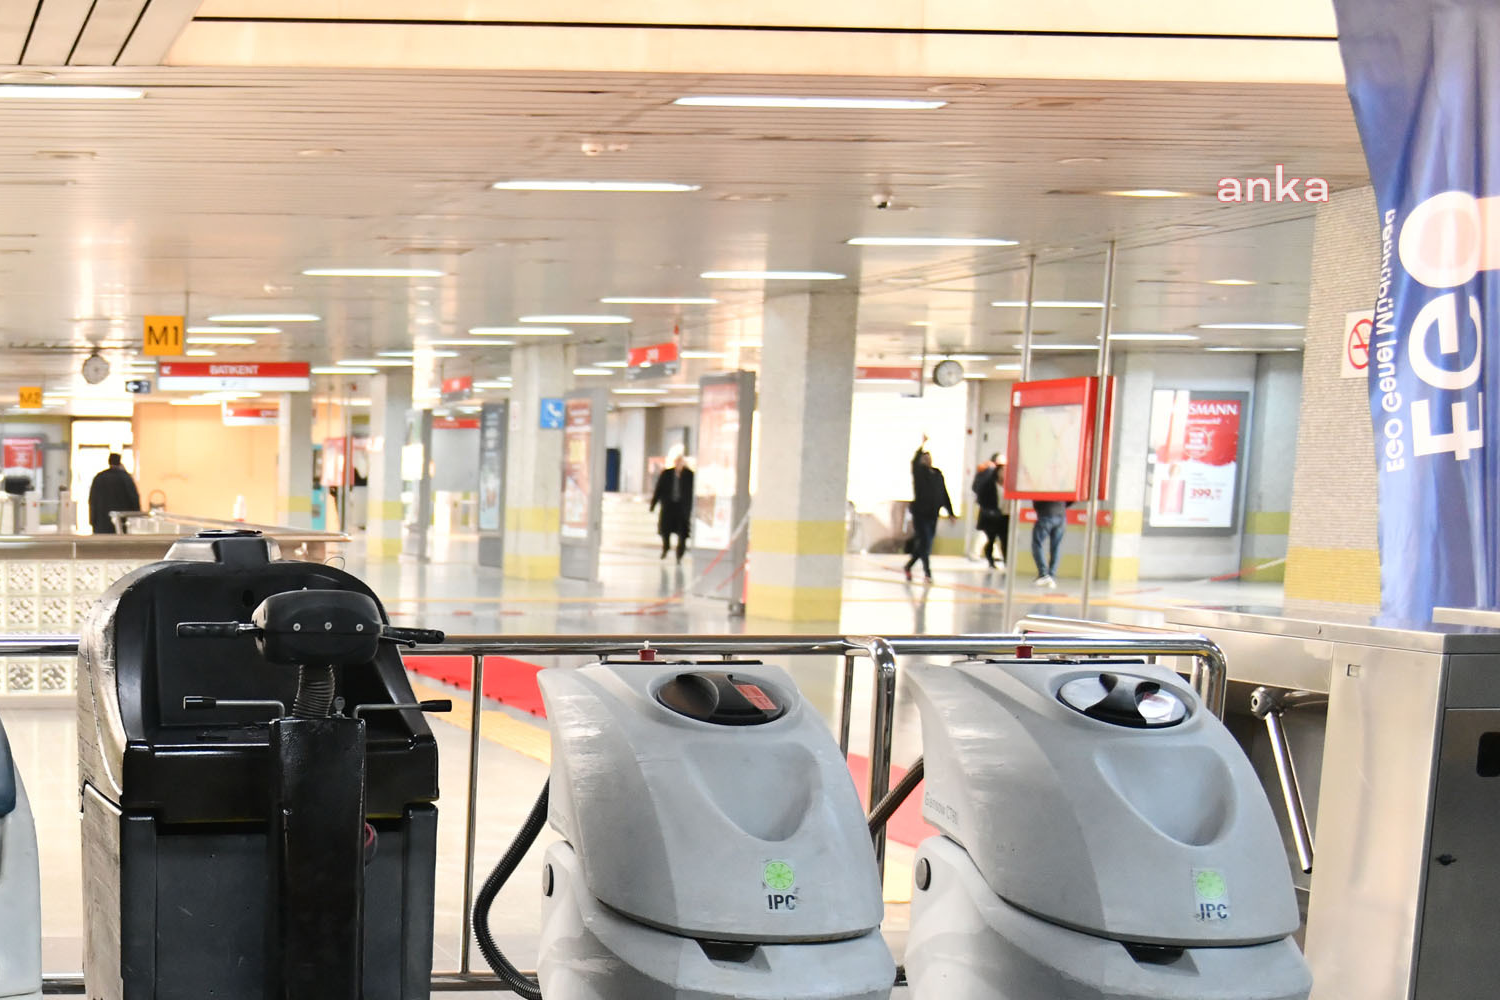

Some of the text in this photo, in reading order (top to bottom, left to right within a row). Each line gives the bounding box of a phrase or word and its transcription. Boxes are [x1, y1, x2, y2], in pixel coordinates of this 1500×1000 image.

[147, 324, 180, 346] M1
[767, 894, 796, 910] IPC
[1200, 903, 1228, 920] IPC
